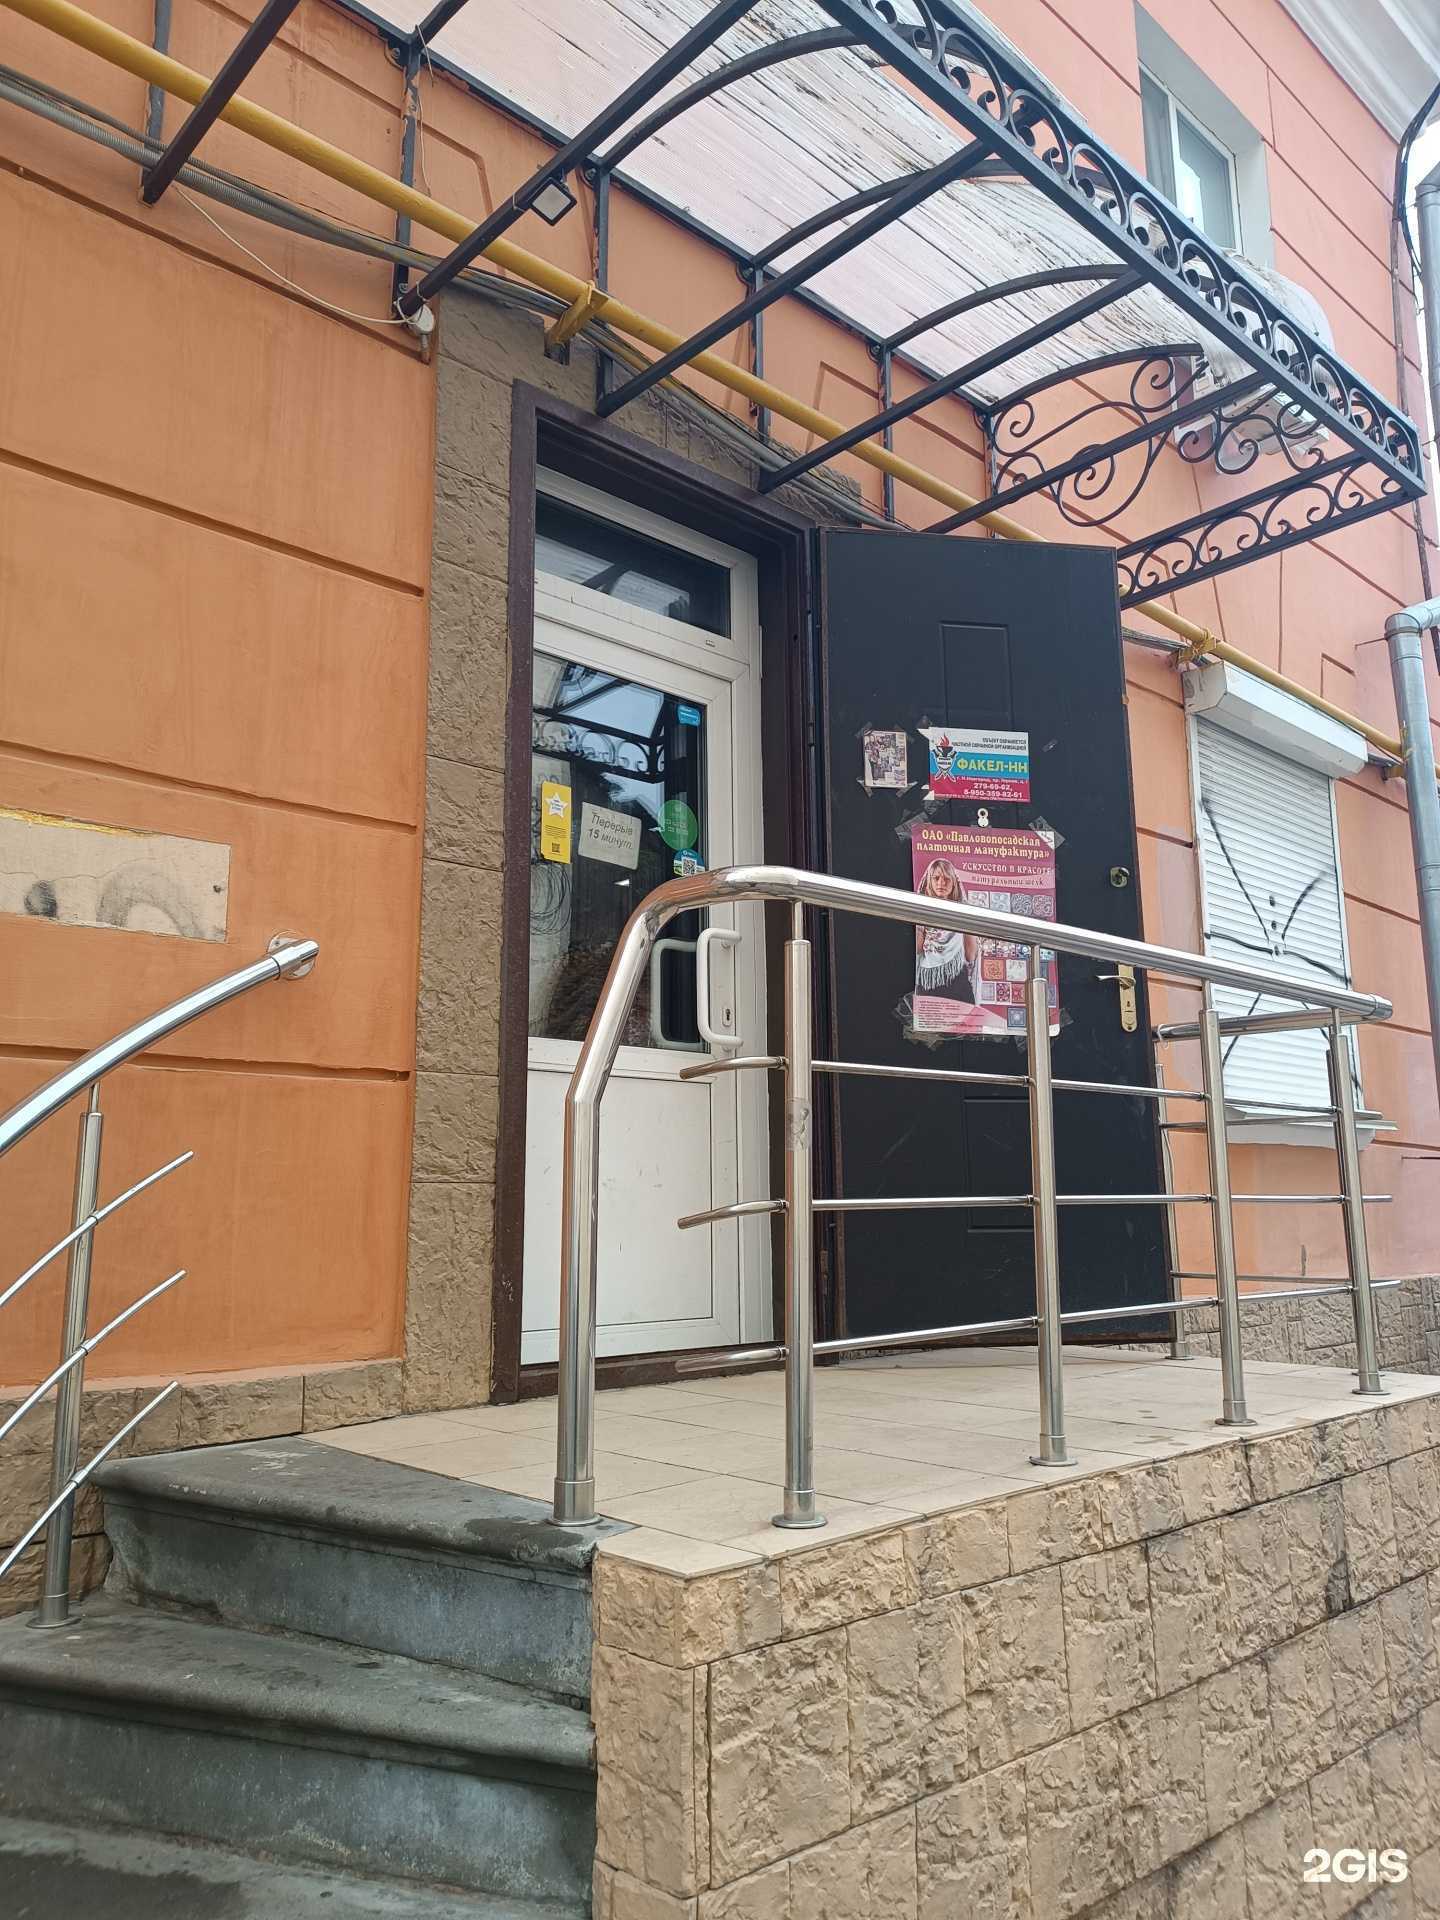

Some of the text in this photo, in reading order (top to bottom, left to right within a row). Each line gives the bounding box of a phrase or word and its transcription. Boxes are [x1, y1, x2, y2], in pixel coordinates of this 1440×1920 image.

[957, 758, 1028, 773] ФАКЕЛ-НН
[589, 828, 600, 839] 15
[591, 814, 633, 836] Перерыв
[922, 829, 1041, 847] ОАО «Павловопосадская
[916, 842, 1050, 859] платочная мануфактура»
